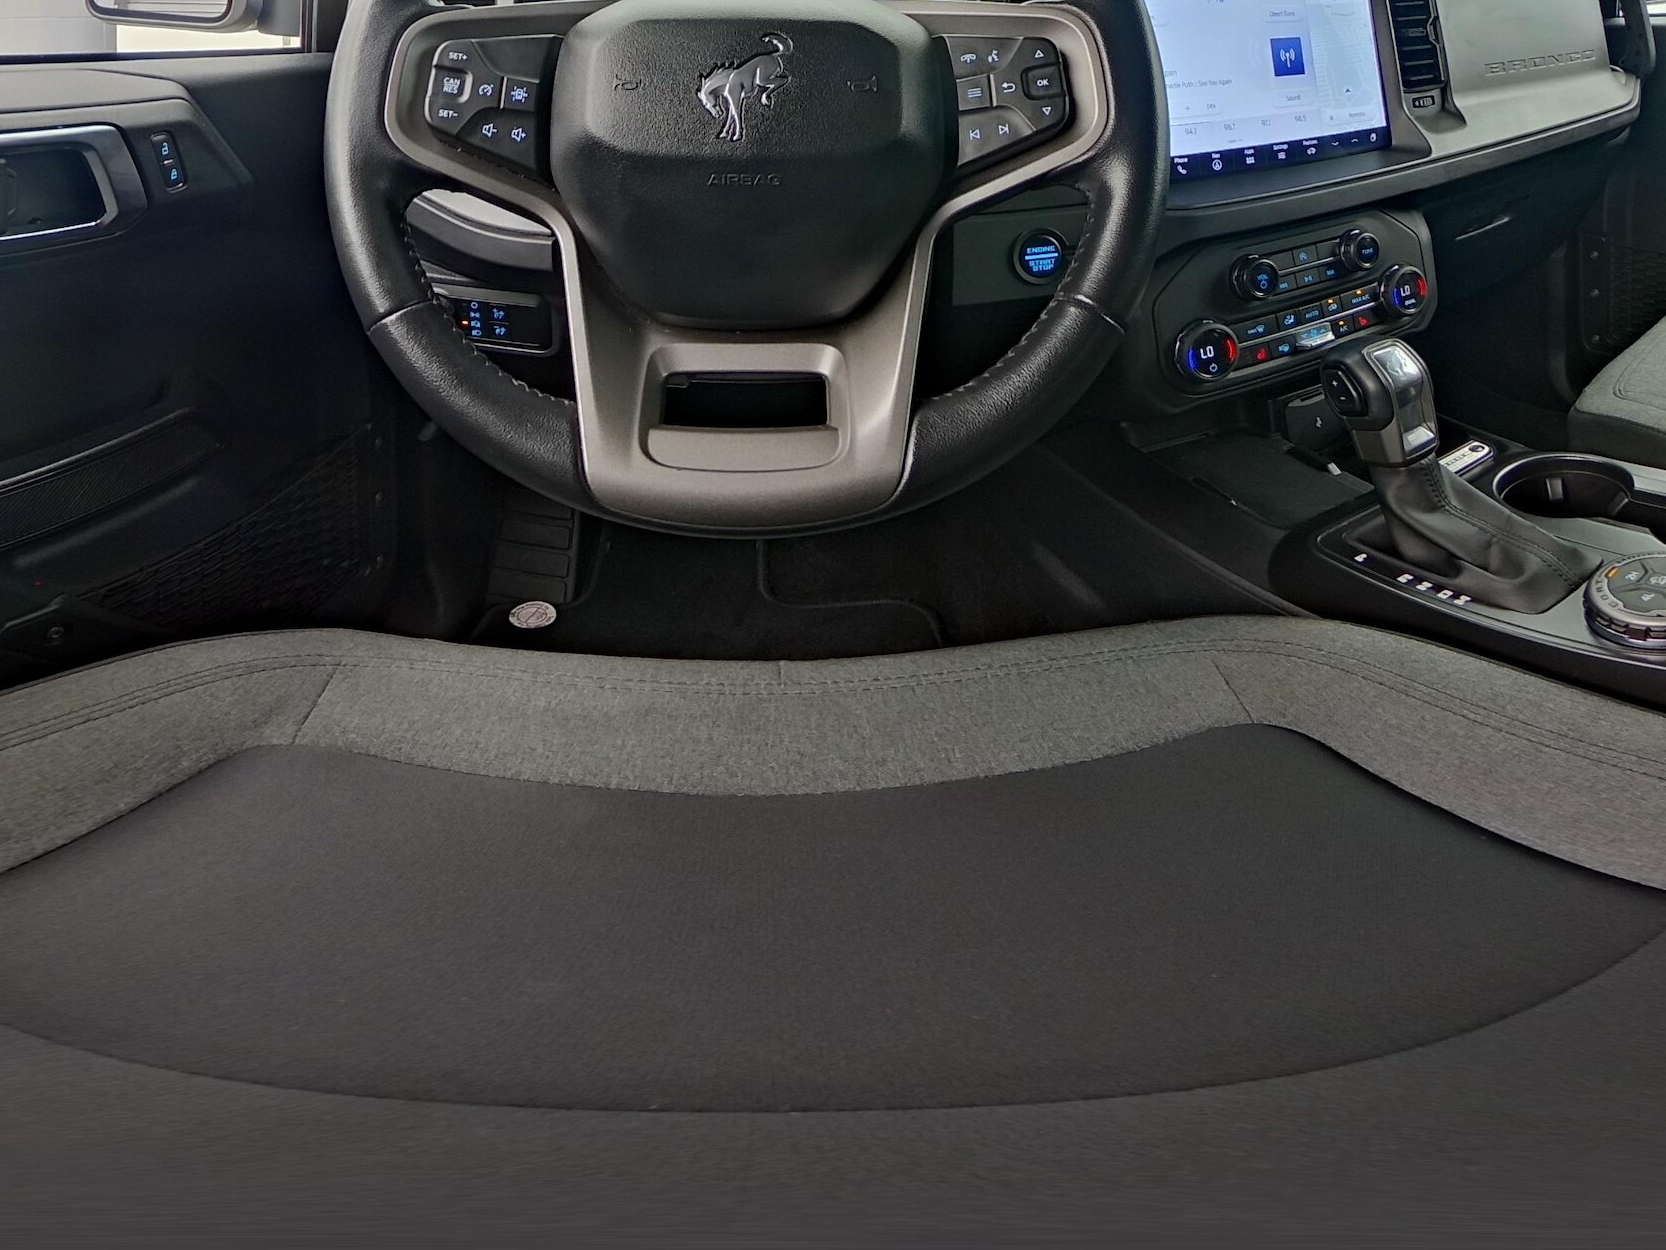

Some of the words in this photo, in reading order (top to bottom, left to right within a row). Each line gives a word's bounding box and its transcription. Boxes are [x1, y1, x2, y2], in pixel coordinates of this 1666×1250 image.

[448, 51, 468, 61] SET+
[443, 77, 461, 85] CAN
[1036, 78, 1050, 87] OK
[442, 85, 459, 94] RES
[1286, 94, 1301, 102] Sound
[1026, 245, 1056, 254] ENGINE
[1028, 258, 1056, 267] START
[1032, 263, 1054, 272] STOP
[1400, 285, 1411, 297] LO
[1305, 310, 1319, 319] AUTO
[1200, 345, 1215, 359] LO
[1625, 571, 1639, 581] 2H
[1641, 593, 1655, 602] 4L
